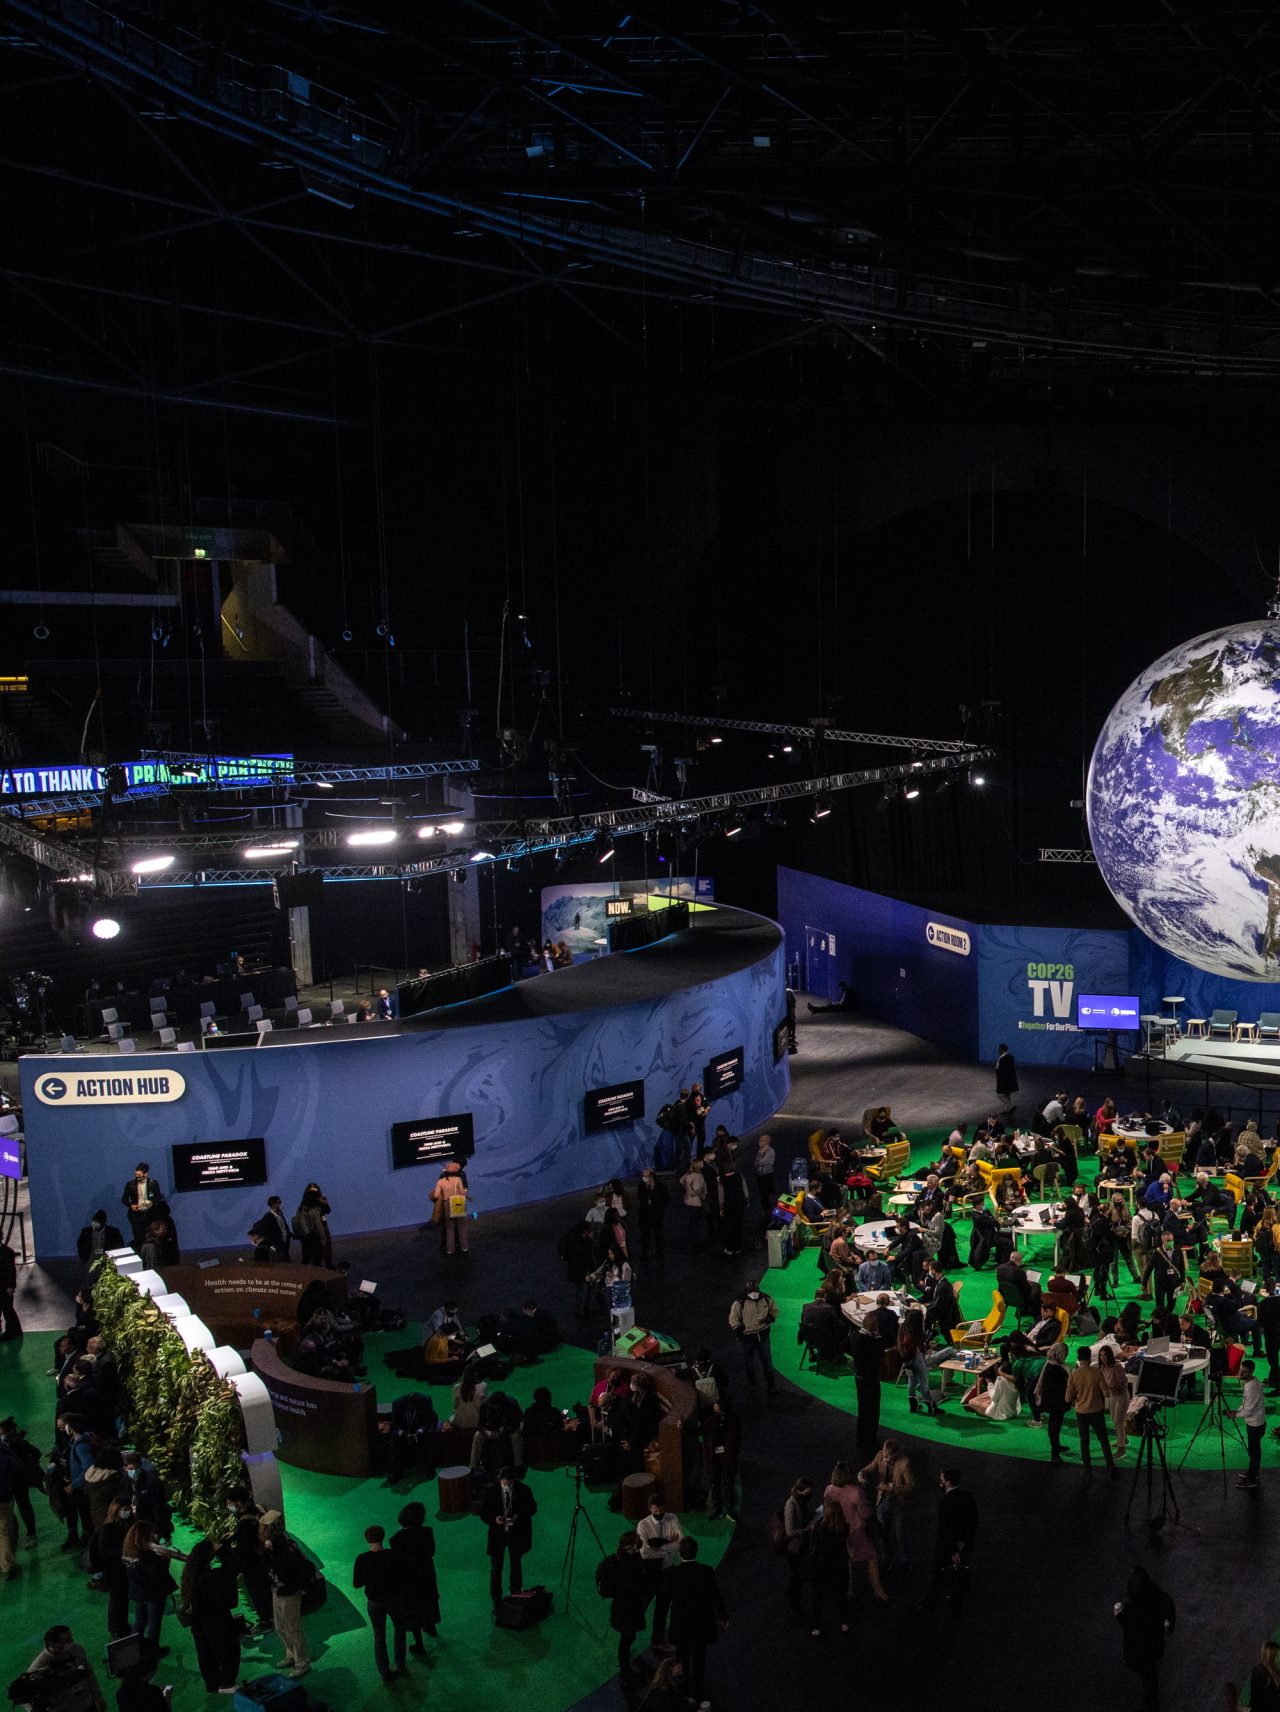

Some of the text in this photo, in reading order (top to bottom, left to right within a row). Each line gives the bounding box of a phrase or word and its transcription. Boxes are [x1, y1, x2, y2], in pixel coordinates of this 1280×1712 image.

[13, 772, 36, 794] TO
[39, 768, 94, 792] THANK
[608, 901, 631, 915] NOW.
[936, 929, 967, 951] ACTION ROOM 2
[1027, 962, 1074, 980] COP26
[1028, 980, 1074, 1018] TV
[76, 1075, 171, 1098] ACTION HUB
[204, 1279, 227, 1287] Health
[228, 1278, 247, 1286] needs
[255, 1278, 263, 1286] be
[271, 1279, 280, 1287] the
[214, 1286, 235, 1294] action
[244, 1286, 267, 1294] climate
